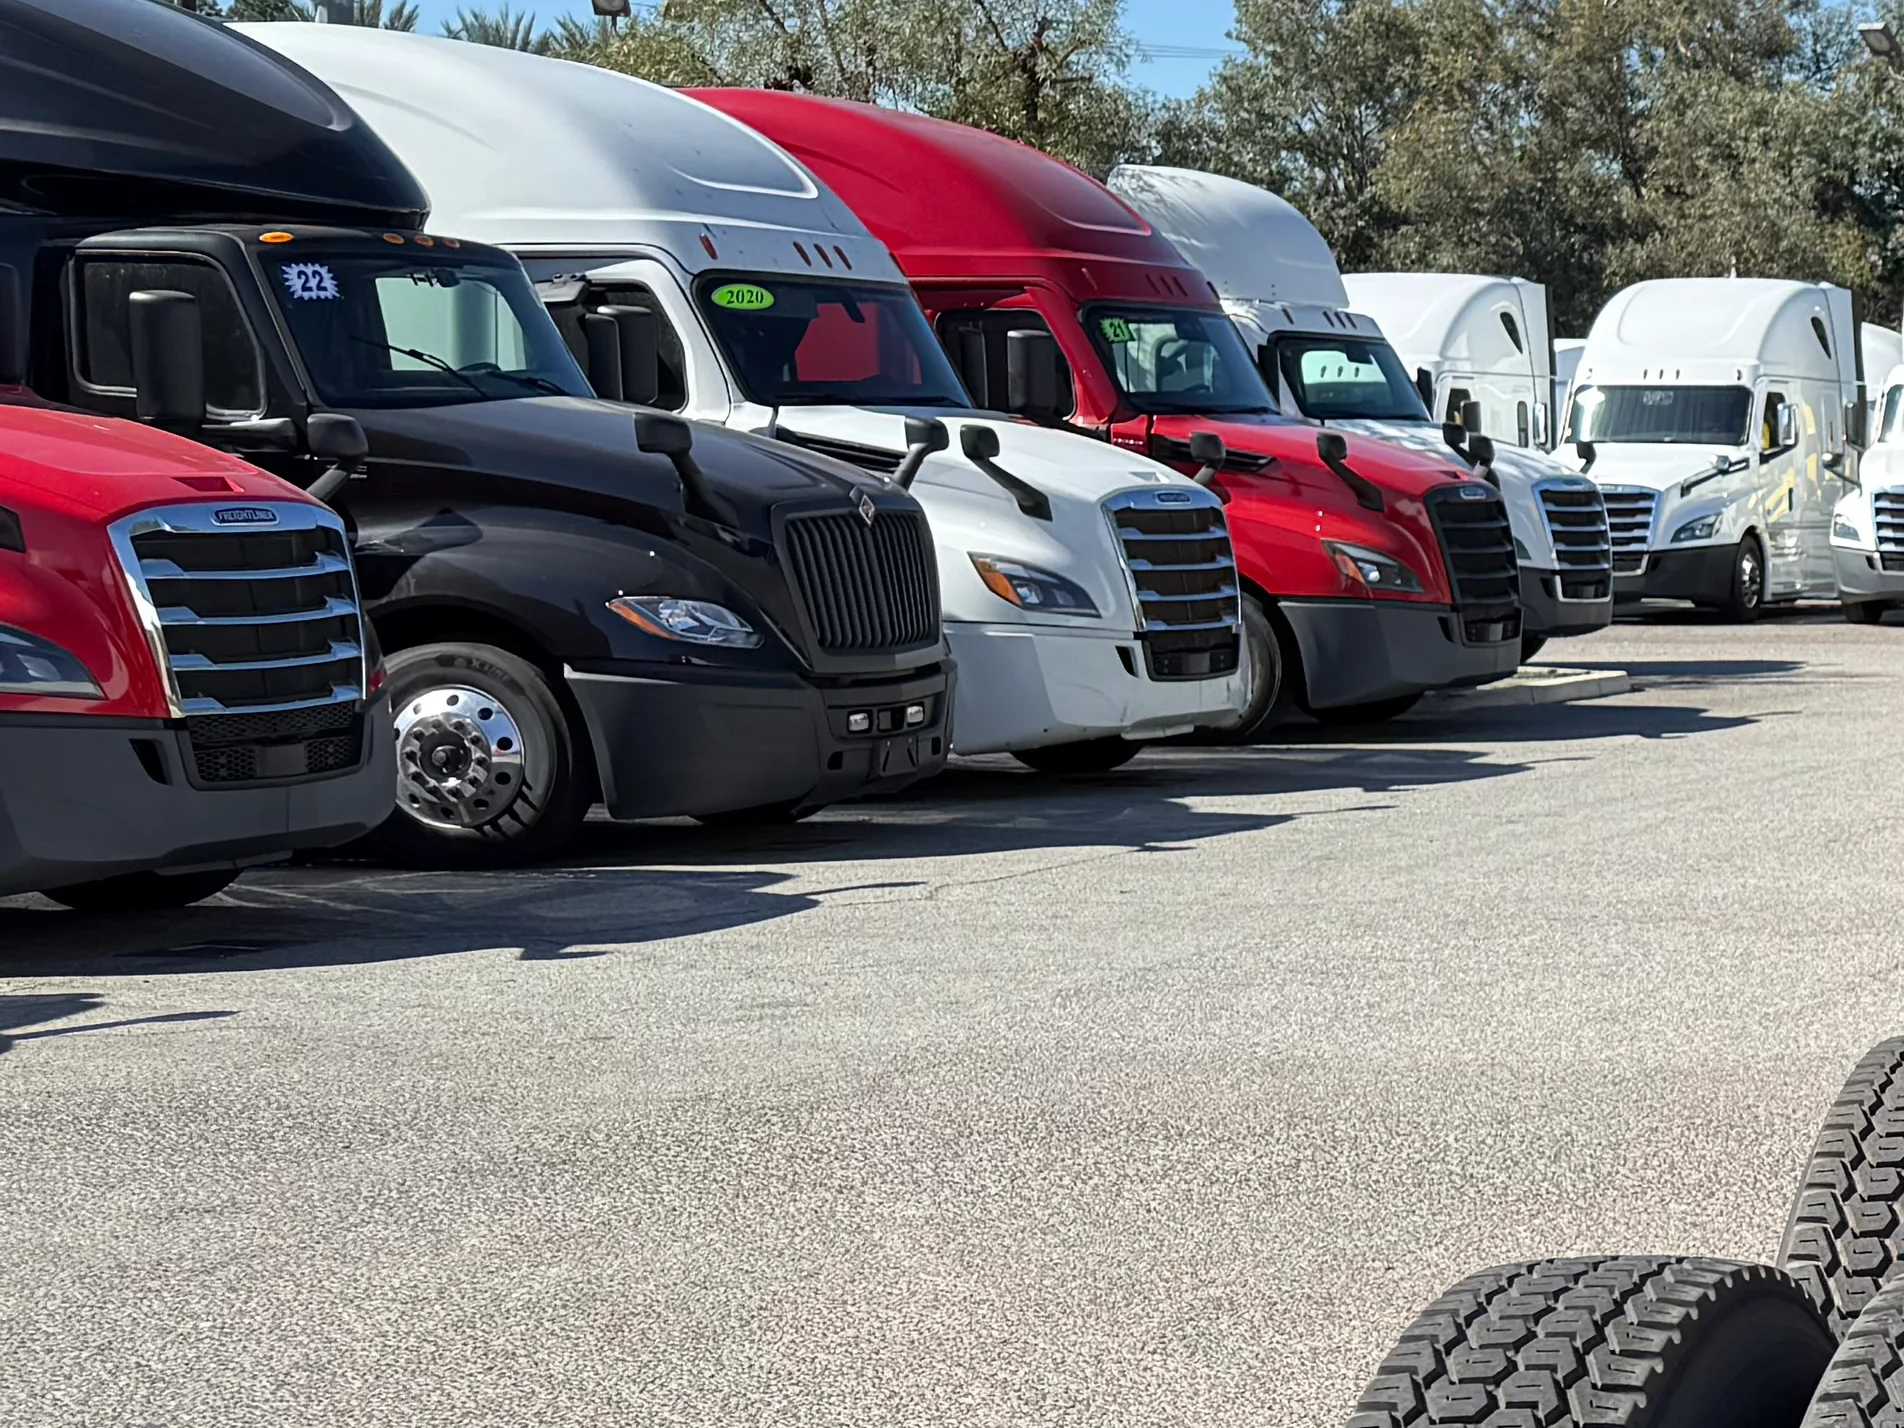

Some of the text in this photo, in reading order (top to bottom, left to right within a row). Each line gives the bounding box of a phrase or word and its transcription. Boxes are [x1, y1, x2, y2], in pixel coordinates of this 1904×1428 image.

[297, 269, 328, 292] 22
[726, 289, 764, 304] 2020
[1109, 321, 1125, 338] 21
